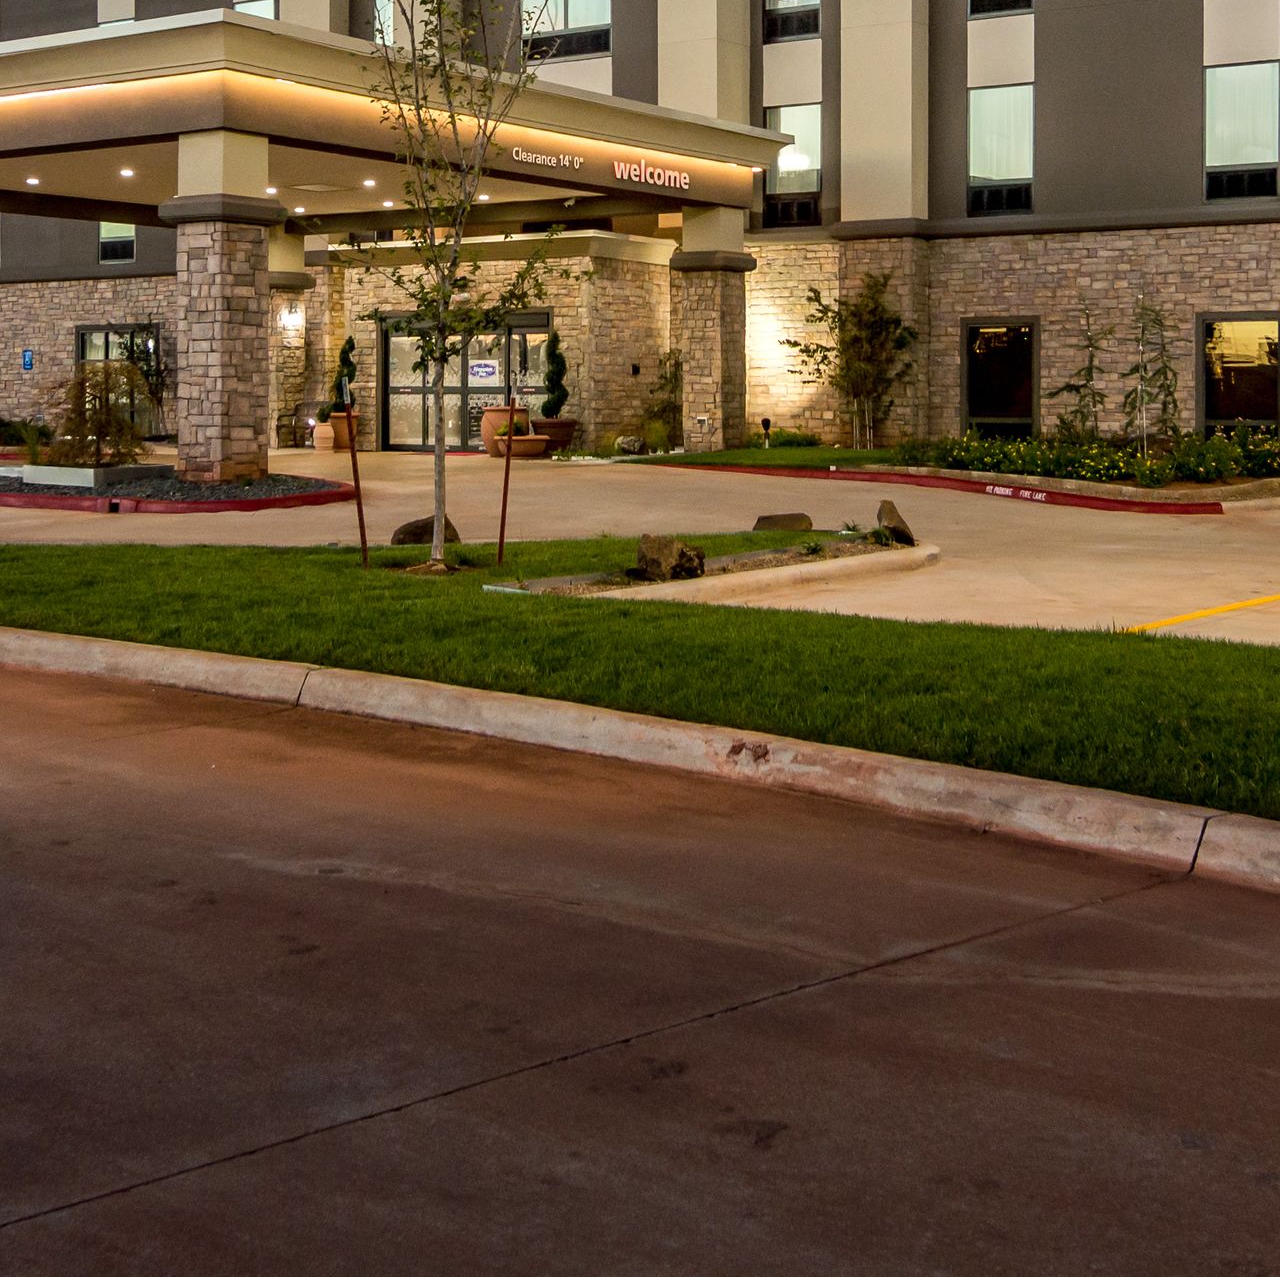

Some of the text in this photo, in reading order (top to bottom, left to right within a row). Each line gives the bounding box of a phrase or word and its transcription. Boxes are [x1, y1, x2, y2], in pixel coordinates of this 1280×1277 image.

[512, 147, 557, 167] Clearance
[559, 153, 572, 168] 14'
[614, 158, 690, 190] welcome
[1020, 489, 1032, 499] FIRE
[1032, 491, 1047, 501] LANE
